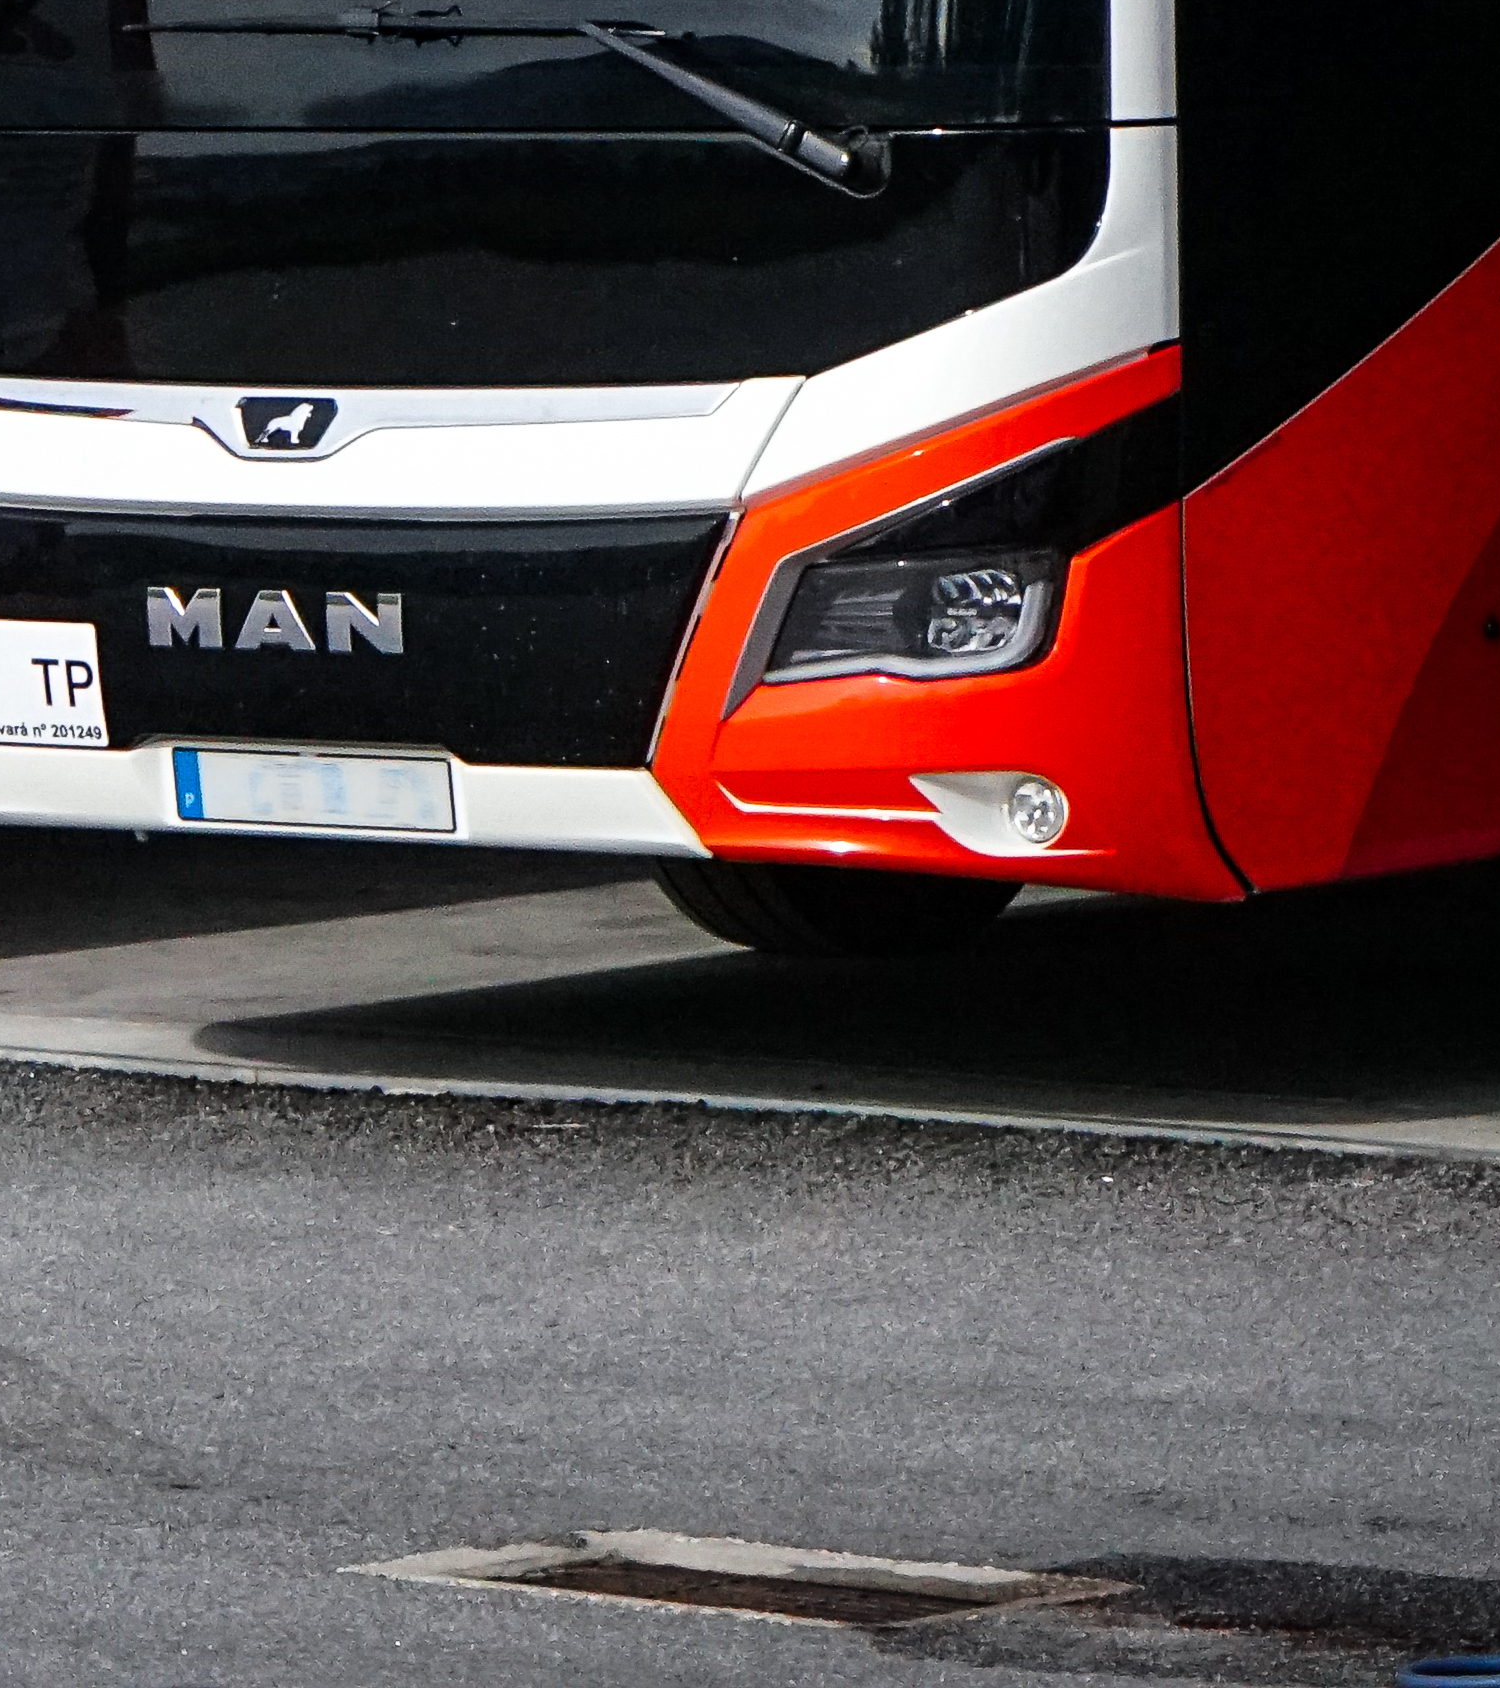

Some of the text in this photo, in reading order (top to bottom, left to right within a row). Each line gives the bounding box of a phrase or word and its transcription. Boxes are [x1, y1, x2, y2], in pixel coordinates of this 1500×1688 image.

[147, 586, 404, 654] MAN
[31, 658, 93, 708] TP
[51, 724, 102, 740] 201249
